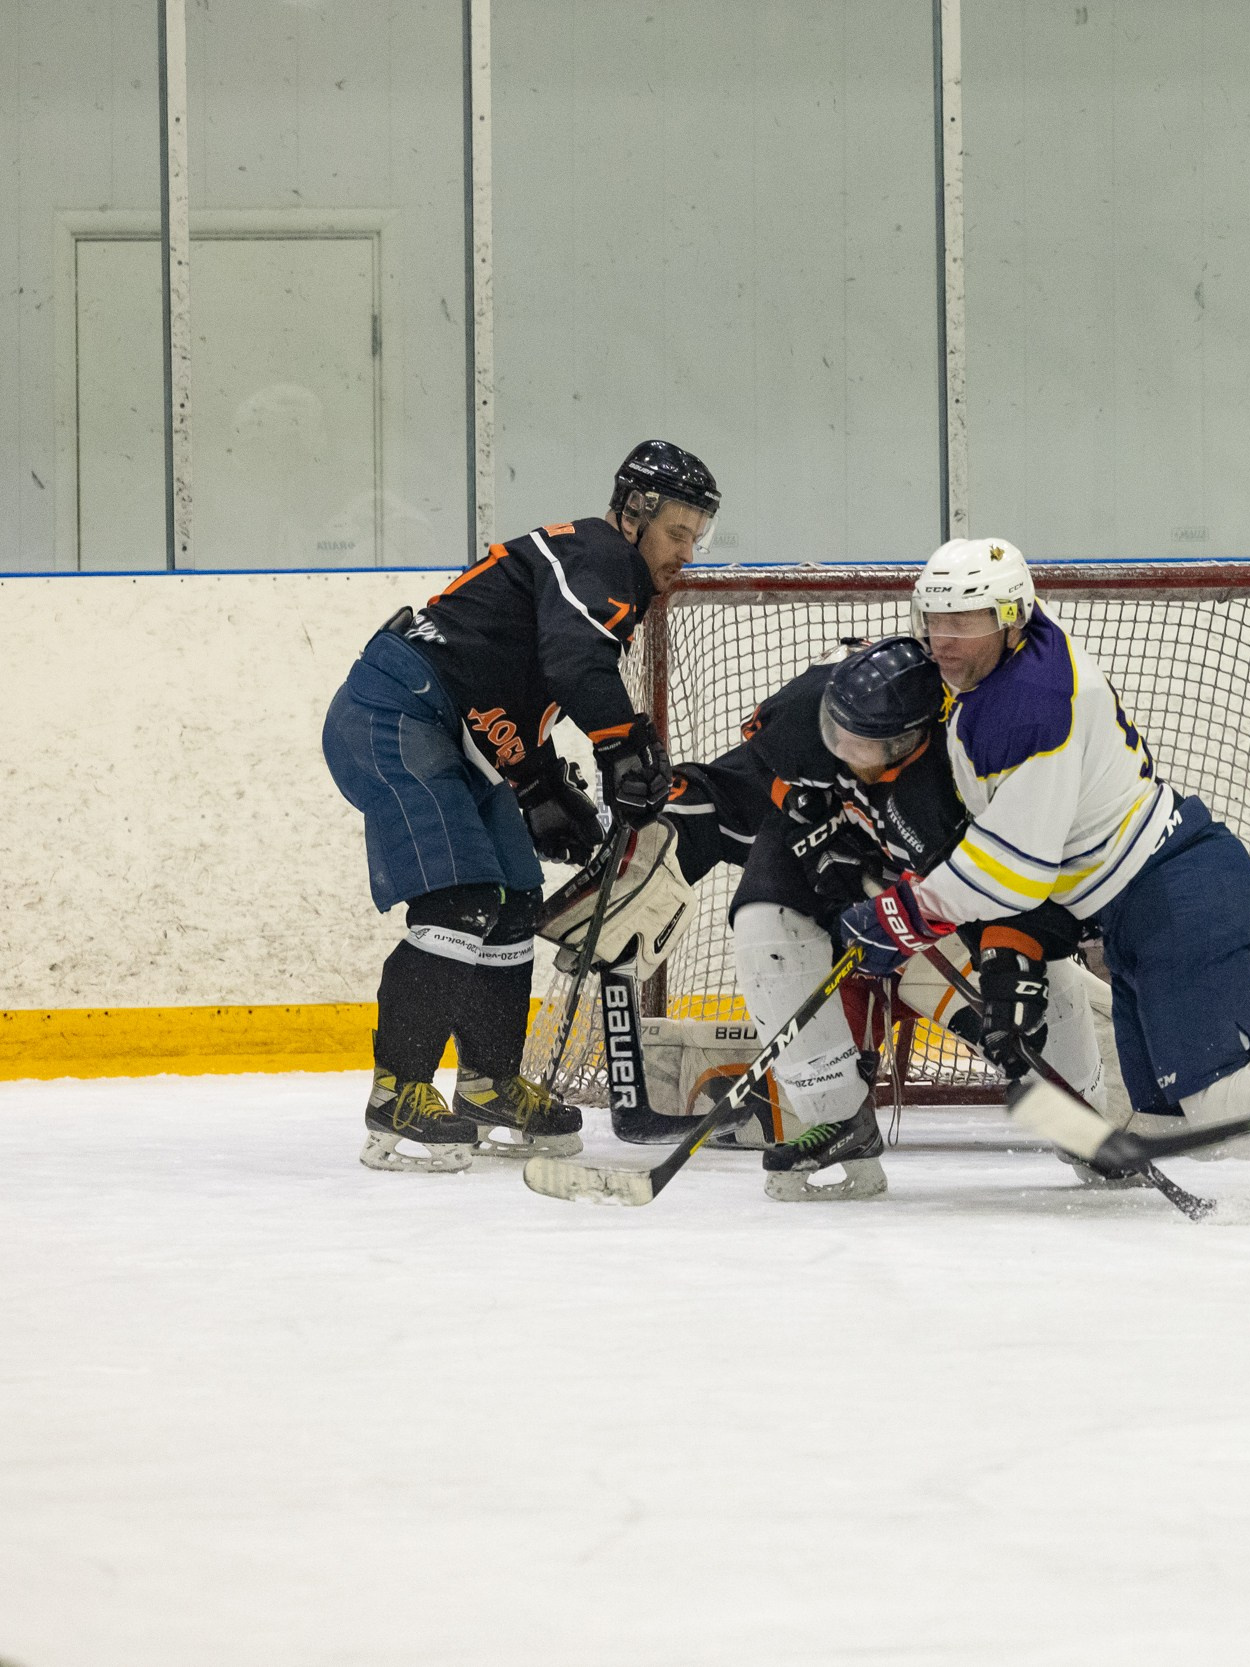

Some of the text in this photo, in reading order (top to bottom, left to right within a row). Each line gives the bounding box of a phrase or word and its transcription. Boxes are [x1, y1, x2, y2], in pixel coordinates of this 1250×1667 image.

[1008, 582, 1024, 594] CCM
[467, 707, 526, 769] ДОБ
[791, 809, 848, 858] CCM
[881, 897, 934, 952] BAU
[824, 960, 853, 996] SUPER
[605, 985, 637, 1109] BAUER
[715, 1027, 757, 1040] BAU
[727, 1017, 799, 1110] CCM
[1157, 1072, 1177, 1089] CM
[829, 1133, 854, 1155] CCM
